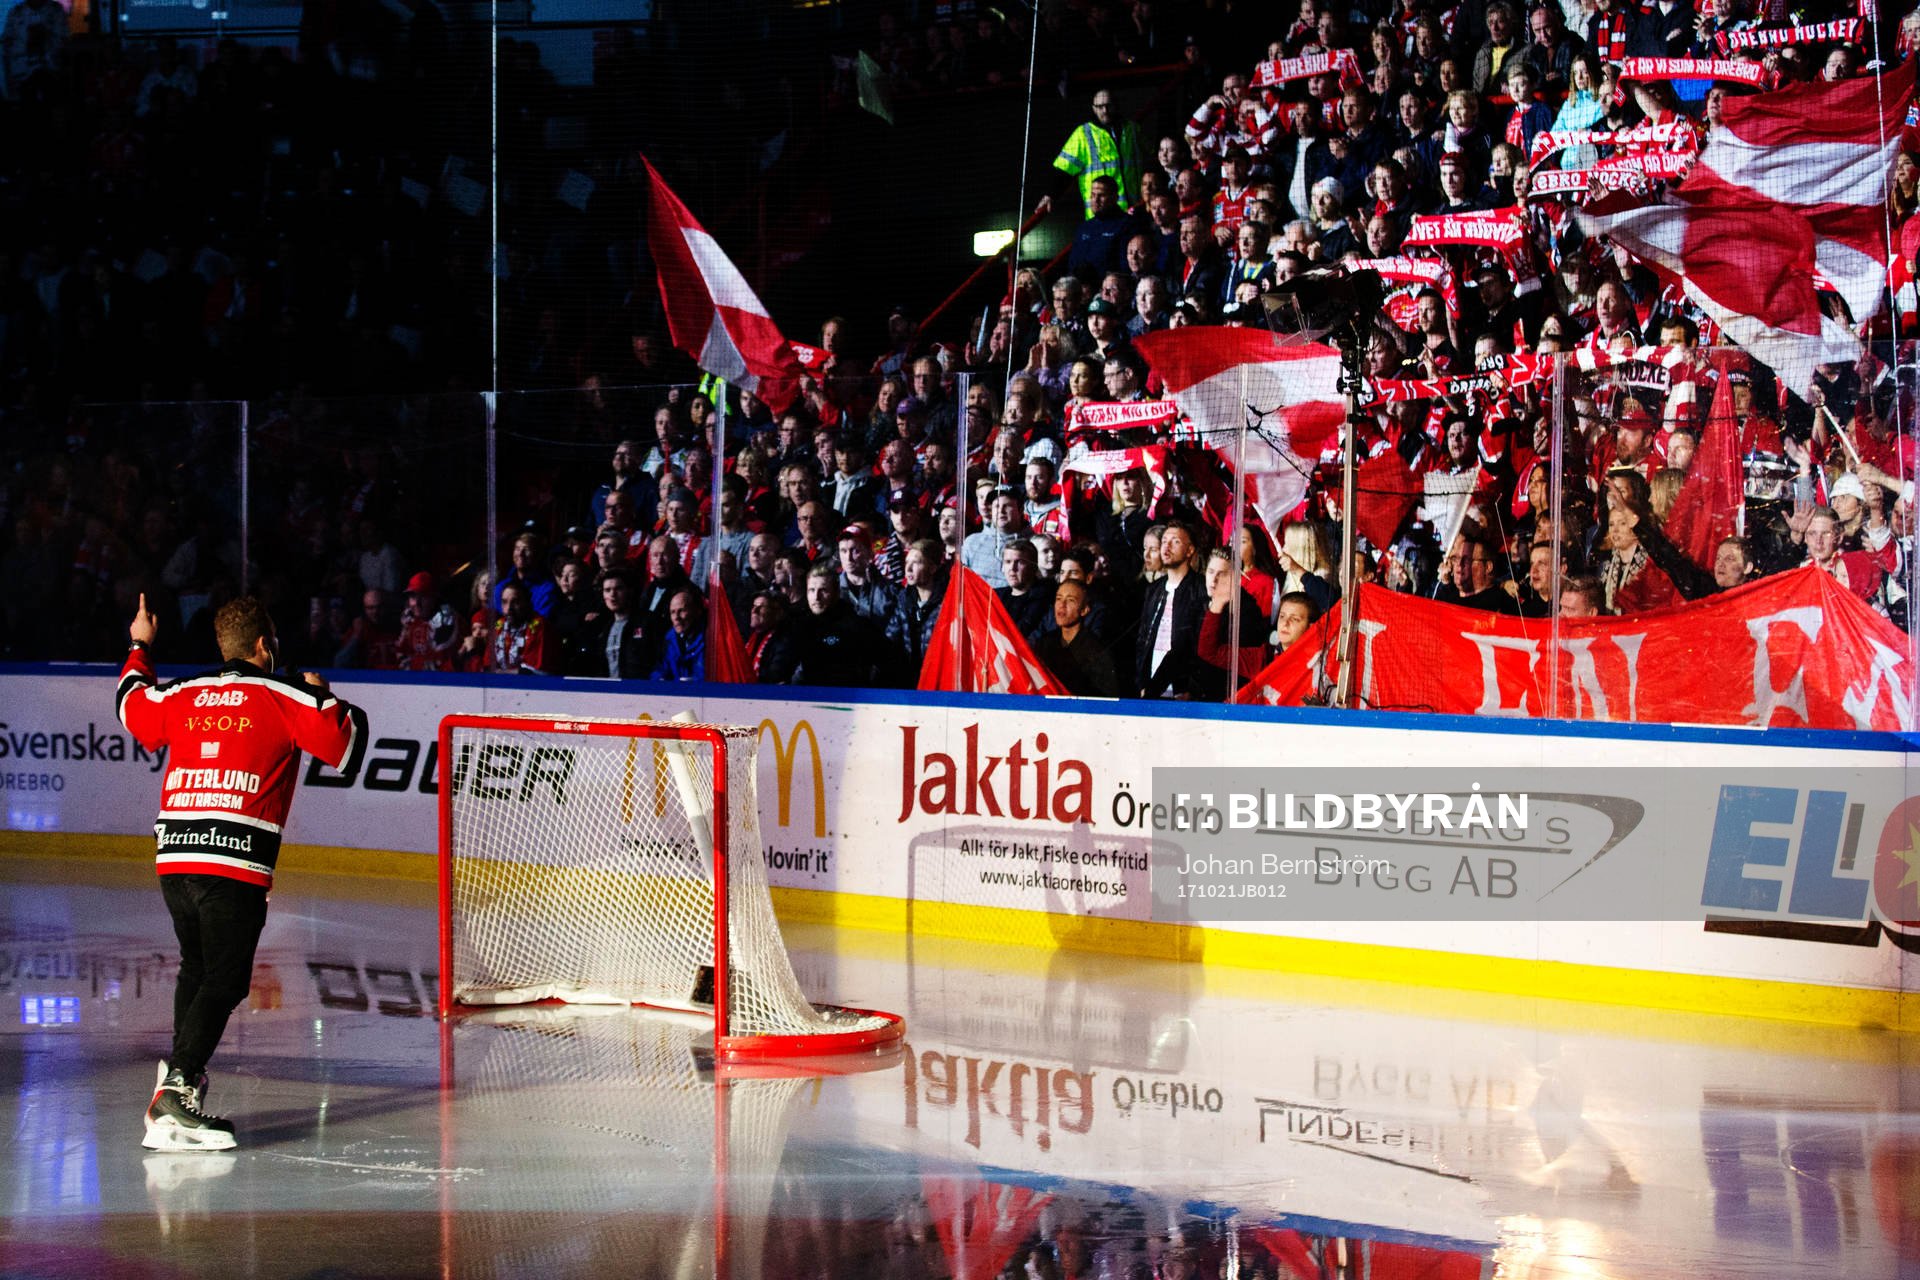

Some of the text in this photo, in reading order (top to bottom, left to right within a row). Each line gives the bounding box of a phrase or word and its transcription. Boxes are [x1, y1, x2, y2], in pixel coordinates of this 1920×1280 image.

[0, 721, 125, 762] Svenska
[897, 722, 1223, 835] Jaktia Örebro
[816, 849, 829, 872] it
[960, 838, 984, 858] Allt
[988, 841, 1007, 861] för
[1082, 849, 1108, 869] och
[1111, 850, 1148, 872] fritid
[979, 869, 1127, 897] www.jaktiaorebro.se
[1448, 855, 1518, 900] AB
